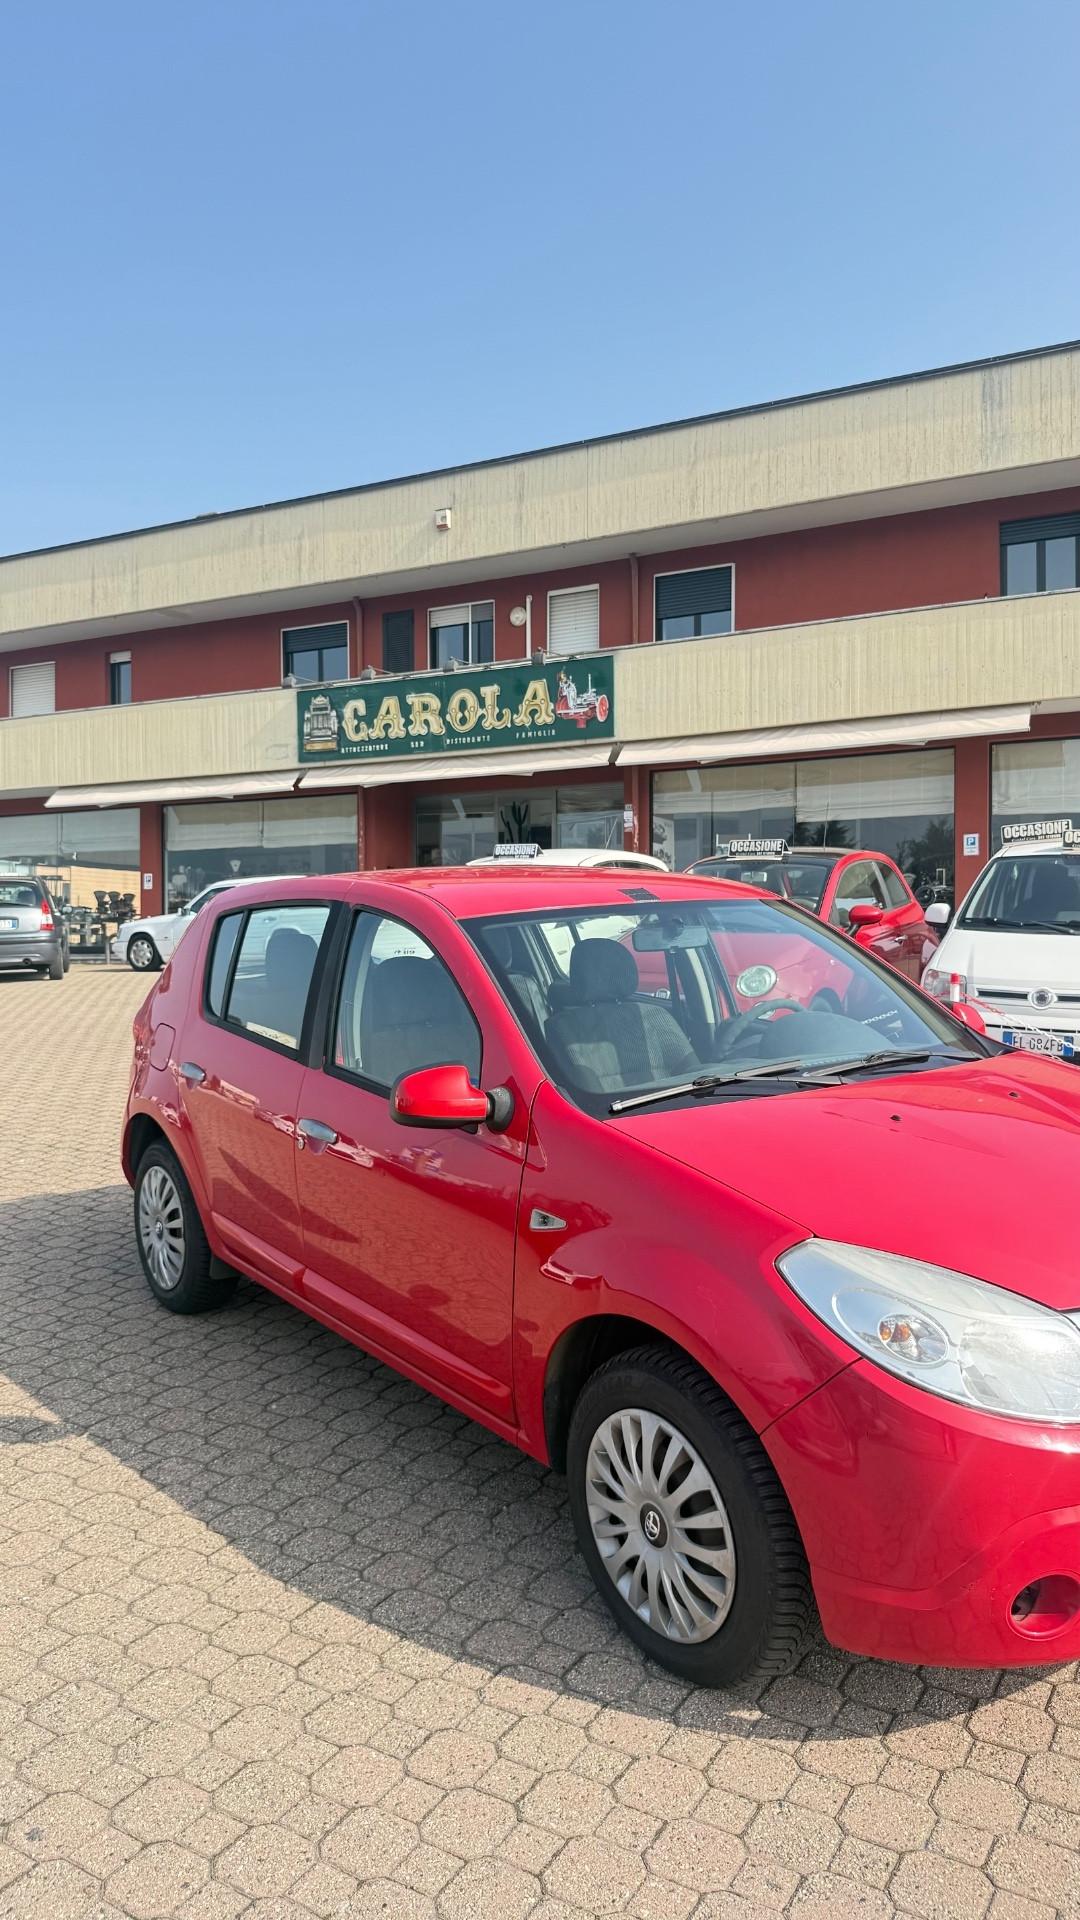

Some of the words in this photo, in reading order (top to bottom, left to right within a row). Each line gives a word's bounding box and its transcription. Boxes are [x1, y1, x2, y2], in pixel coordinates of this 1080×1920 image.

[342, 678, 555, 742] CAROLA
[446, 735, 491, 745] RISTORANTE
[516, 729, 556, 739] FAMIGLIA
[1003, 821, 1068, 839] OCCASIONE
[495, 845, 535, 856] OCCASIONE
[730, 840, 782, 852] OCCASIONE
